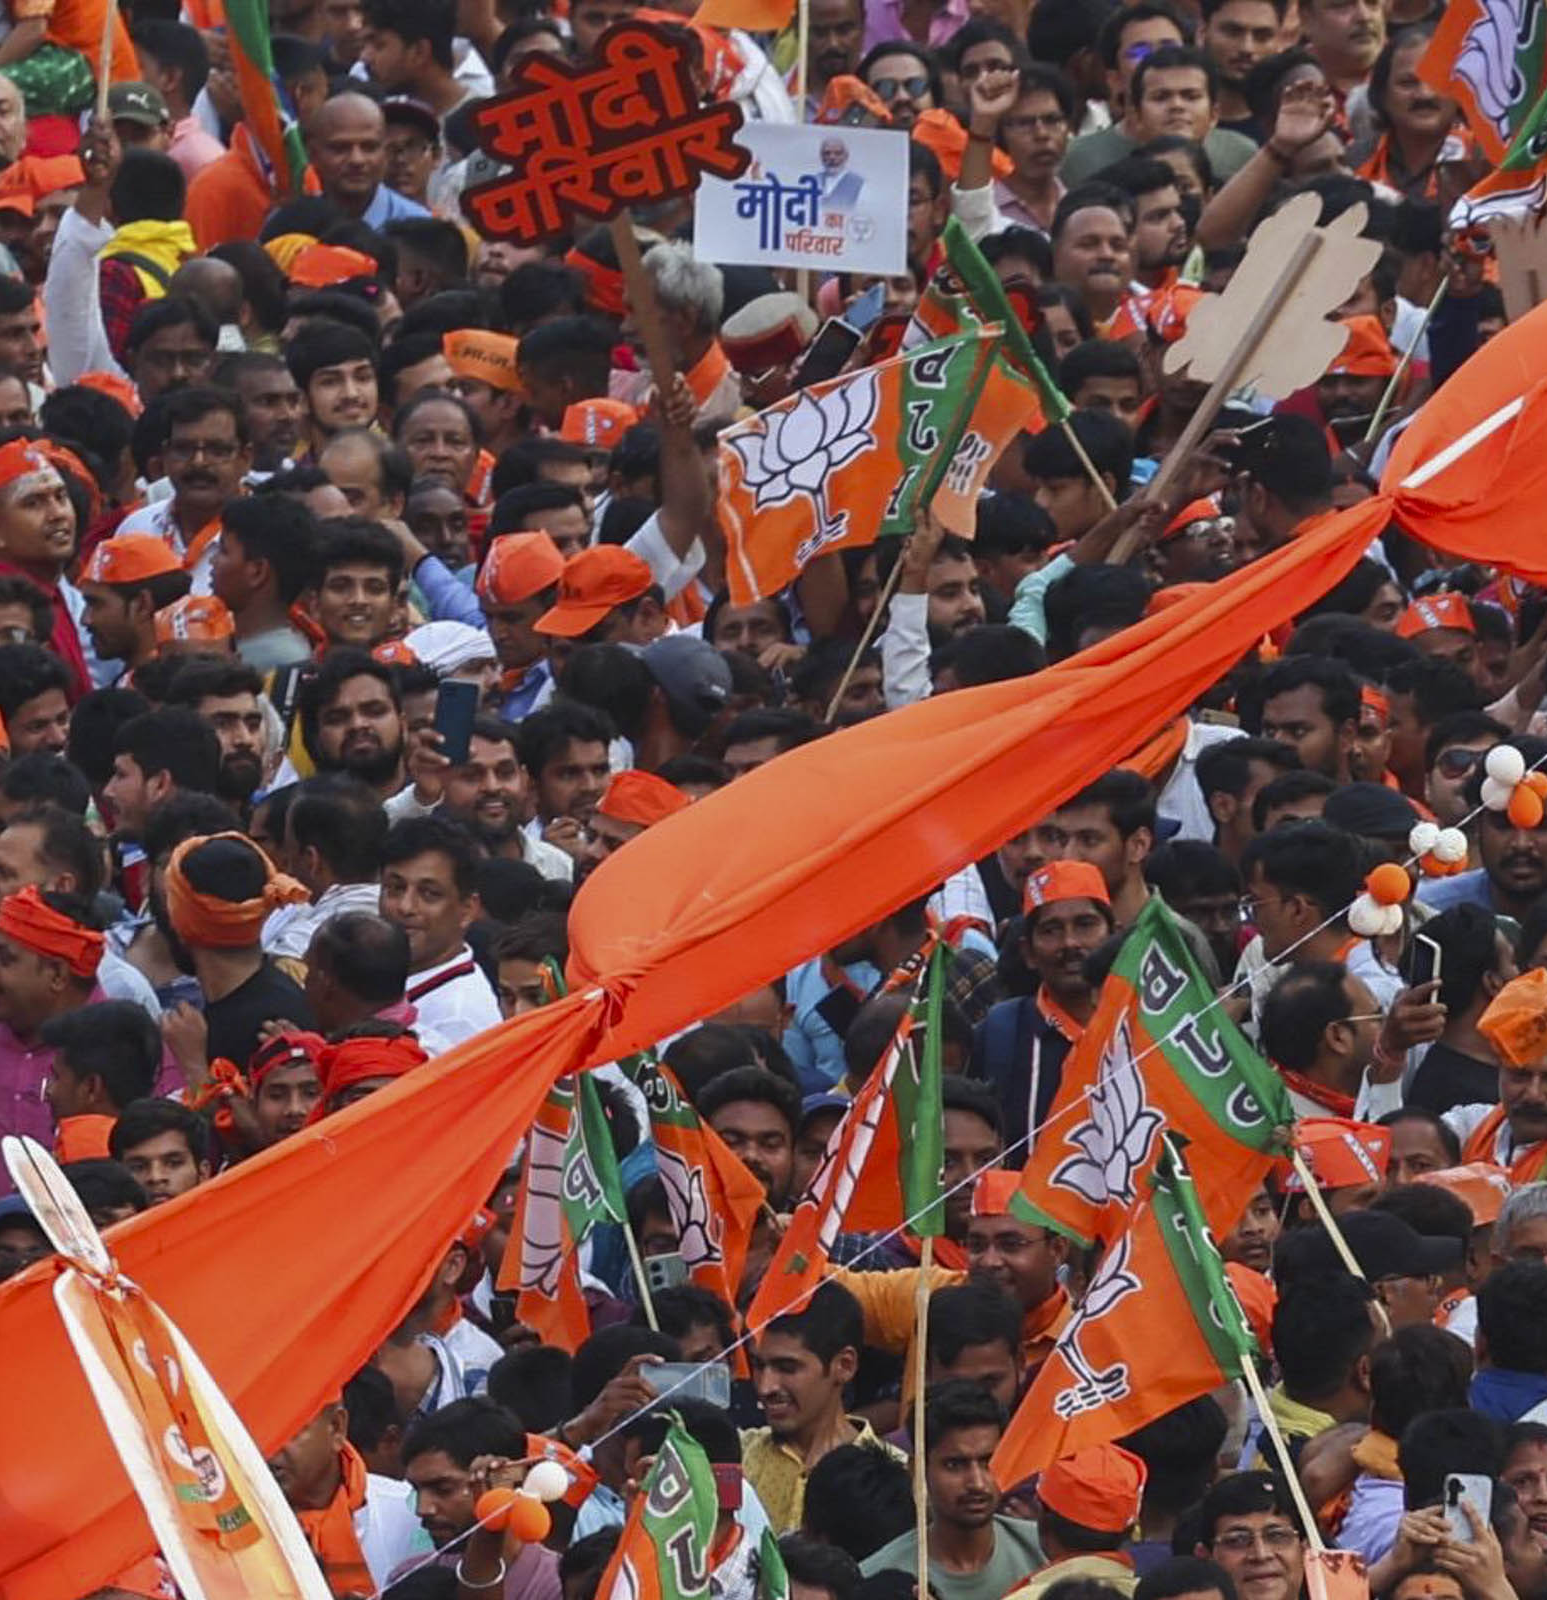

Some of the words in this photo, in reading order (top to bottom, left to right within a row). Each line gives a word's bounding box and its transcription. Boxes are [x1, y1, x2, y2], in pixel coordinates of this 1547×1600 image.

[476, 30, 690, 150] मोदी
[472, 111, 742, 239] परिवार
[733, 173, 822, 251] मोदी
[784, 230, 845, 256] परिवार
